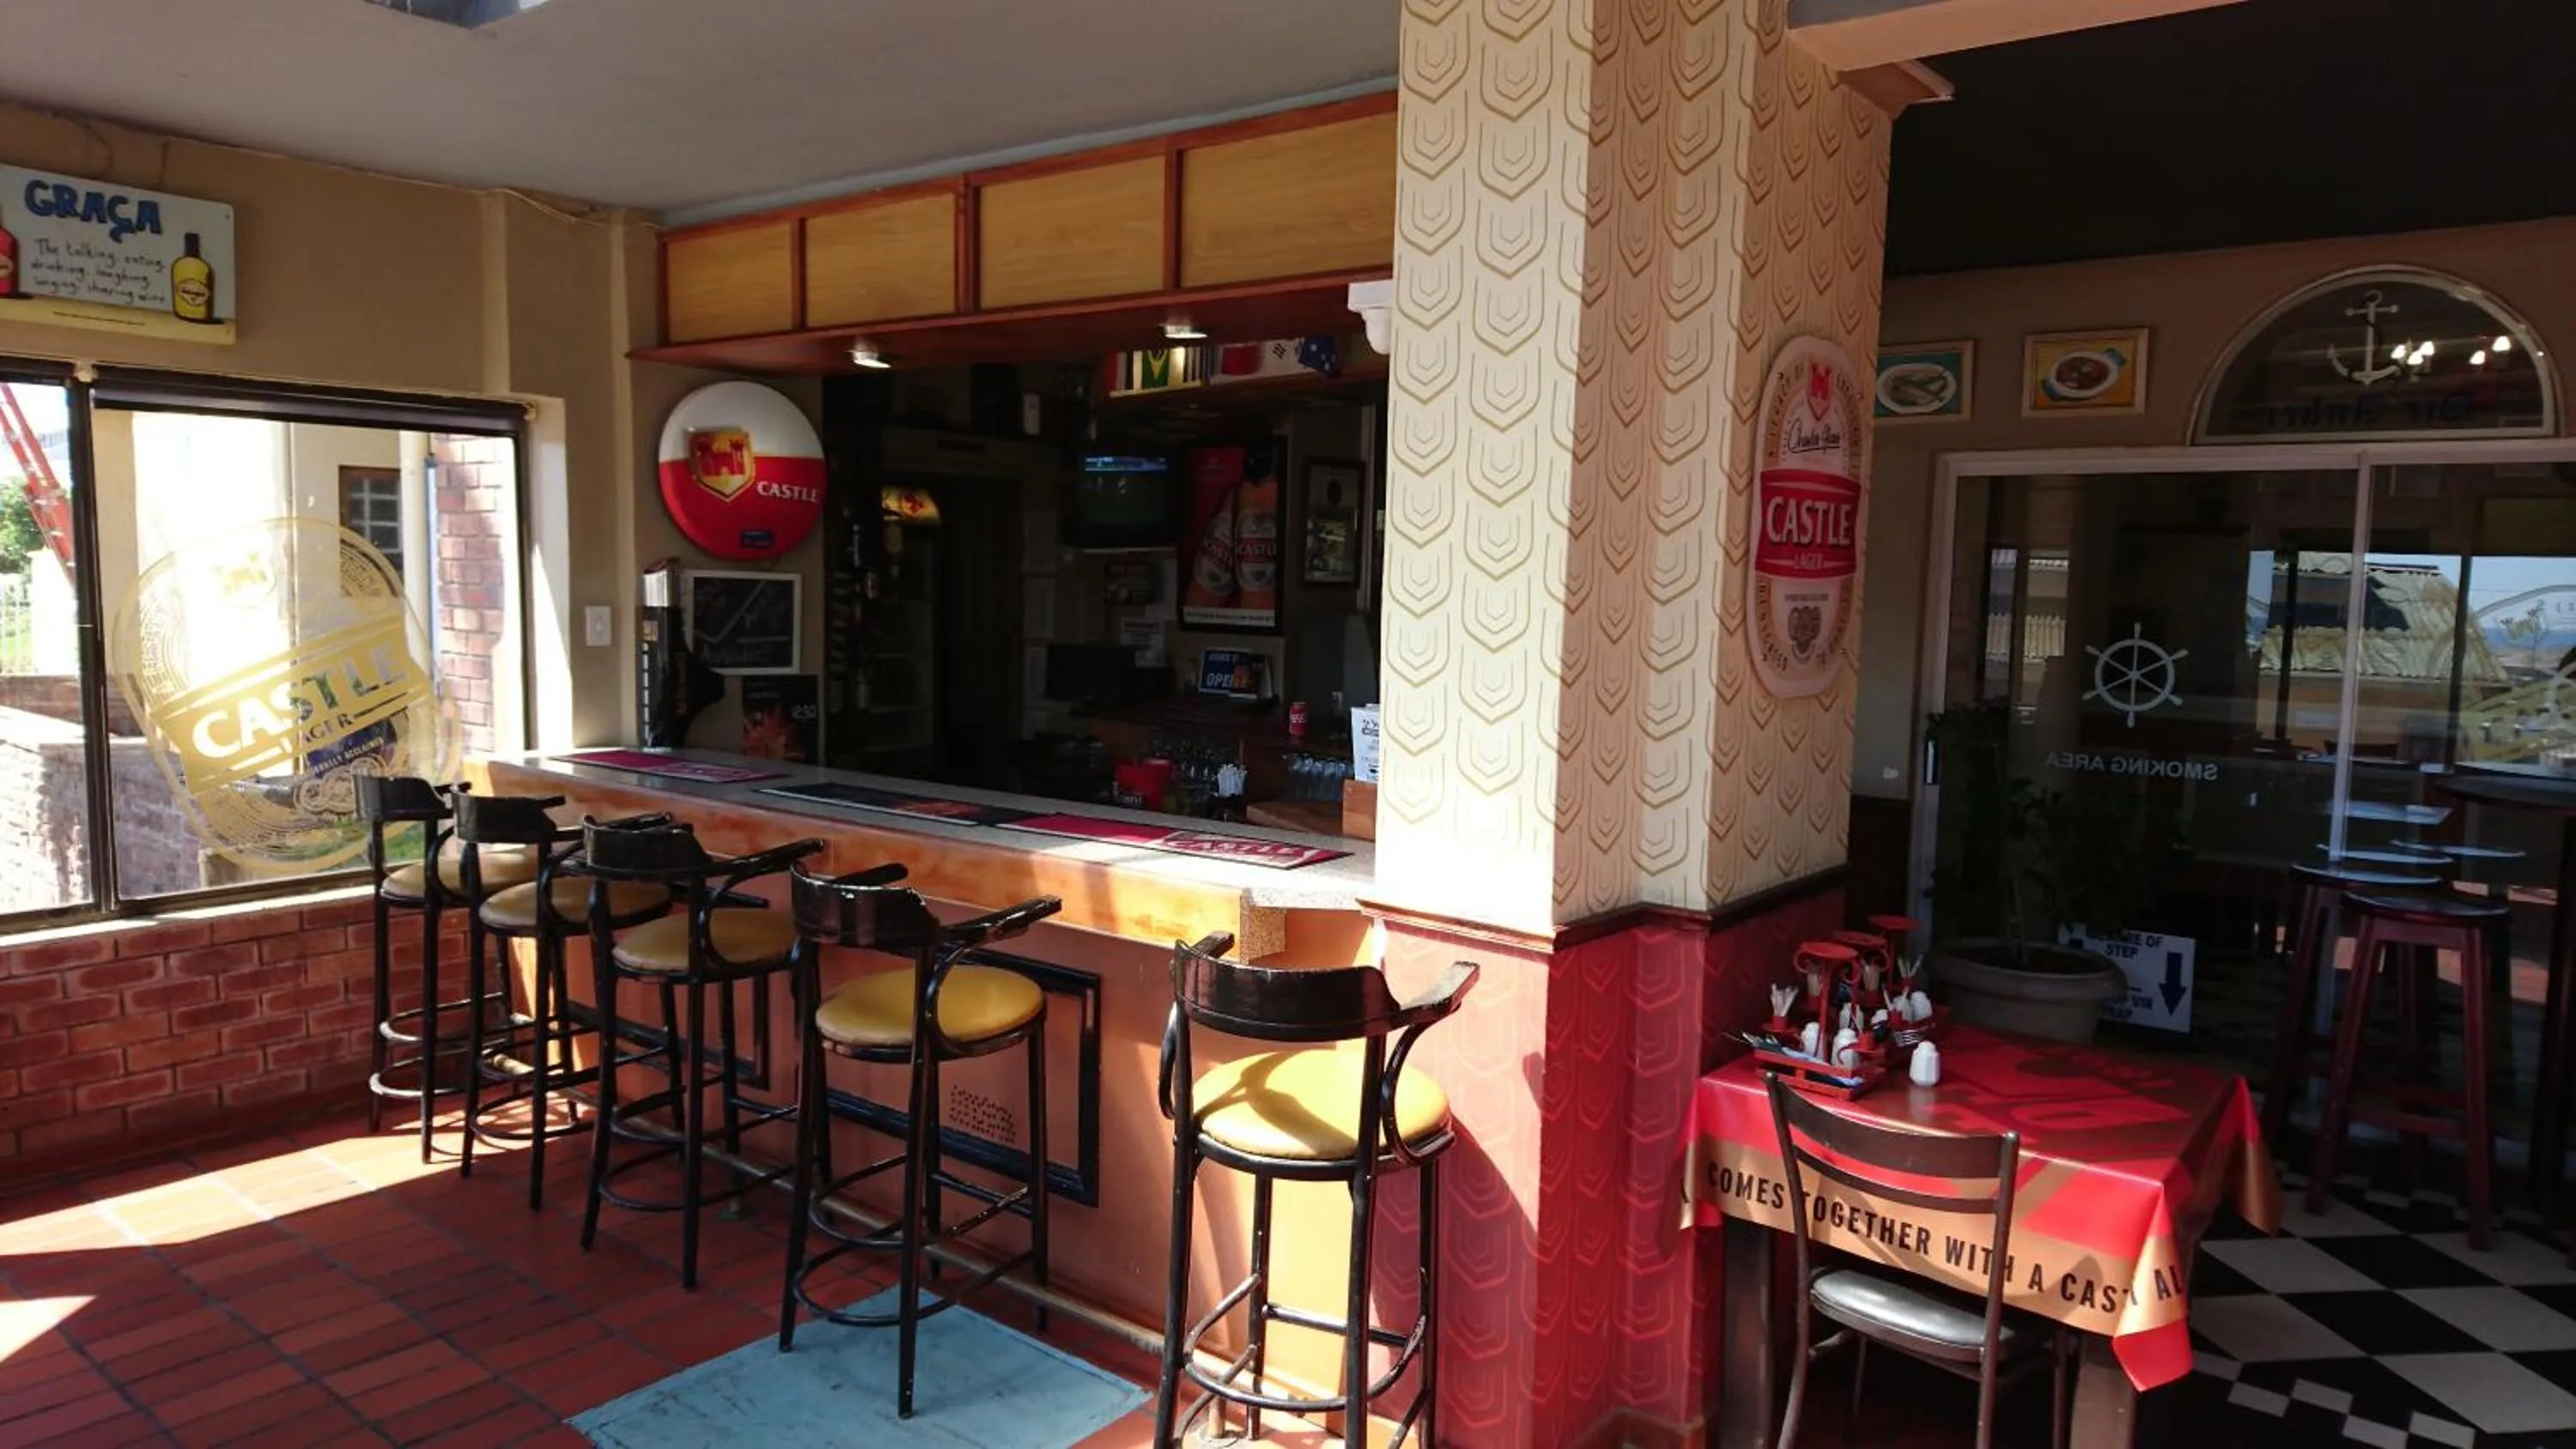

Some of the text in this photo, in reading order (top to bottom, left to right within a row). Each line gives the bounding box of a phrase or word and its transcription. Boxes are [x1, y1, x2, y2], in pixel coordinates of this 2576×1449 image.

[24, 179, 162, 244] GRAÇA
[34, 238, 59, 256] The
[755, 479, 820, 504] CASTLE
[1765, 494, 1854, 549] CASTLE
[191, 640, 408, 759] CASTLE
[2105, 943, 2139, 959] STEP
[2147, 935, 2164, 948] OF
[1707, 1161, 1785, 1210] COMES
[1945, 1235, 2015, 1283] WITH
[2028, 1264, 2045, 1294] A
